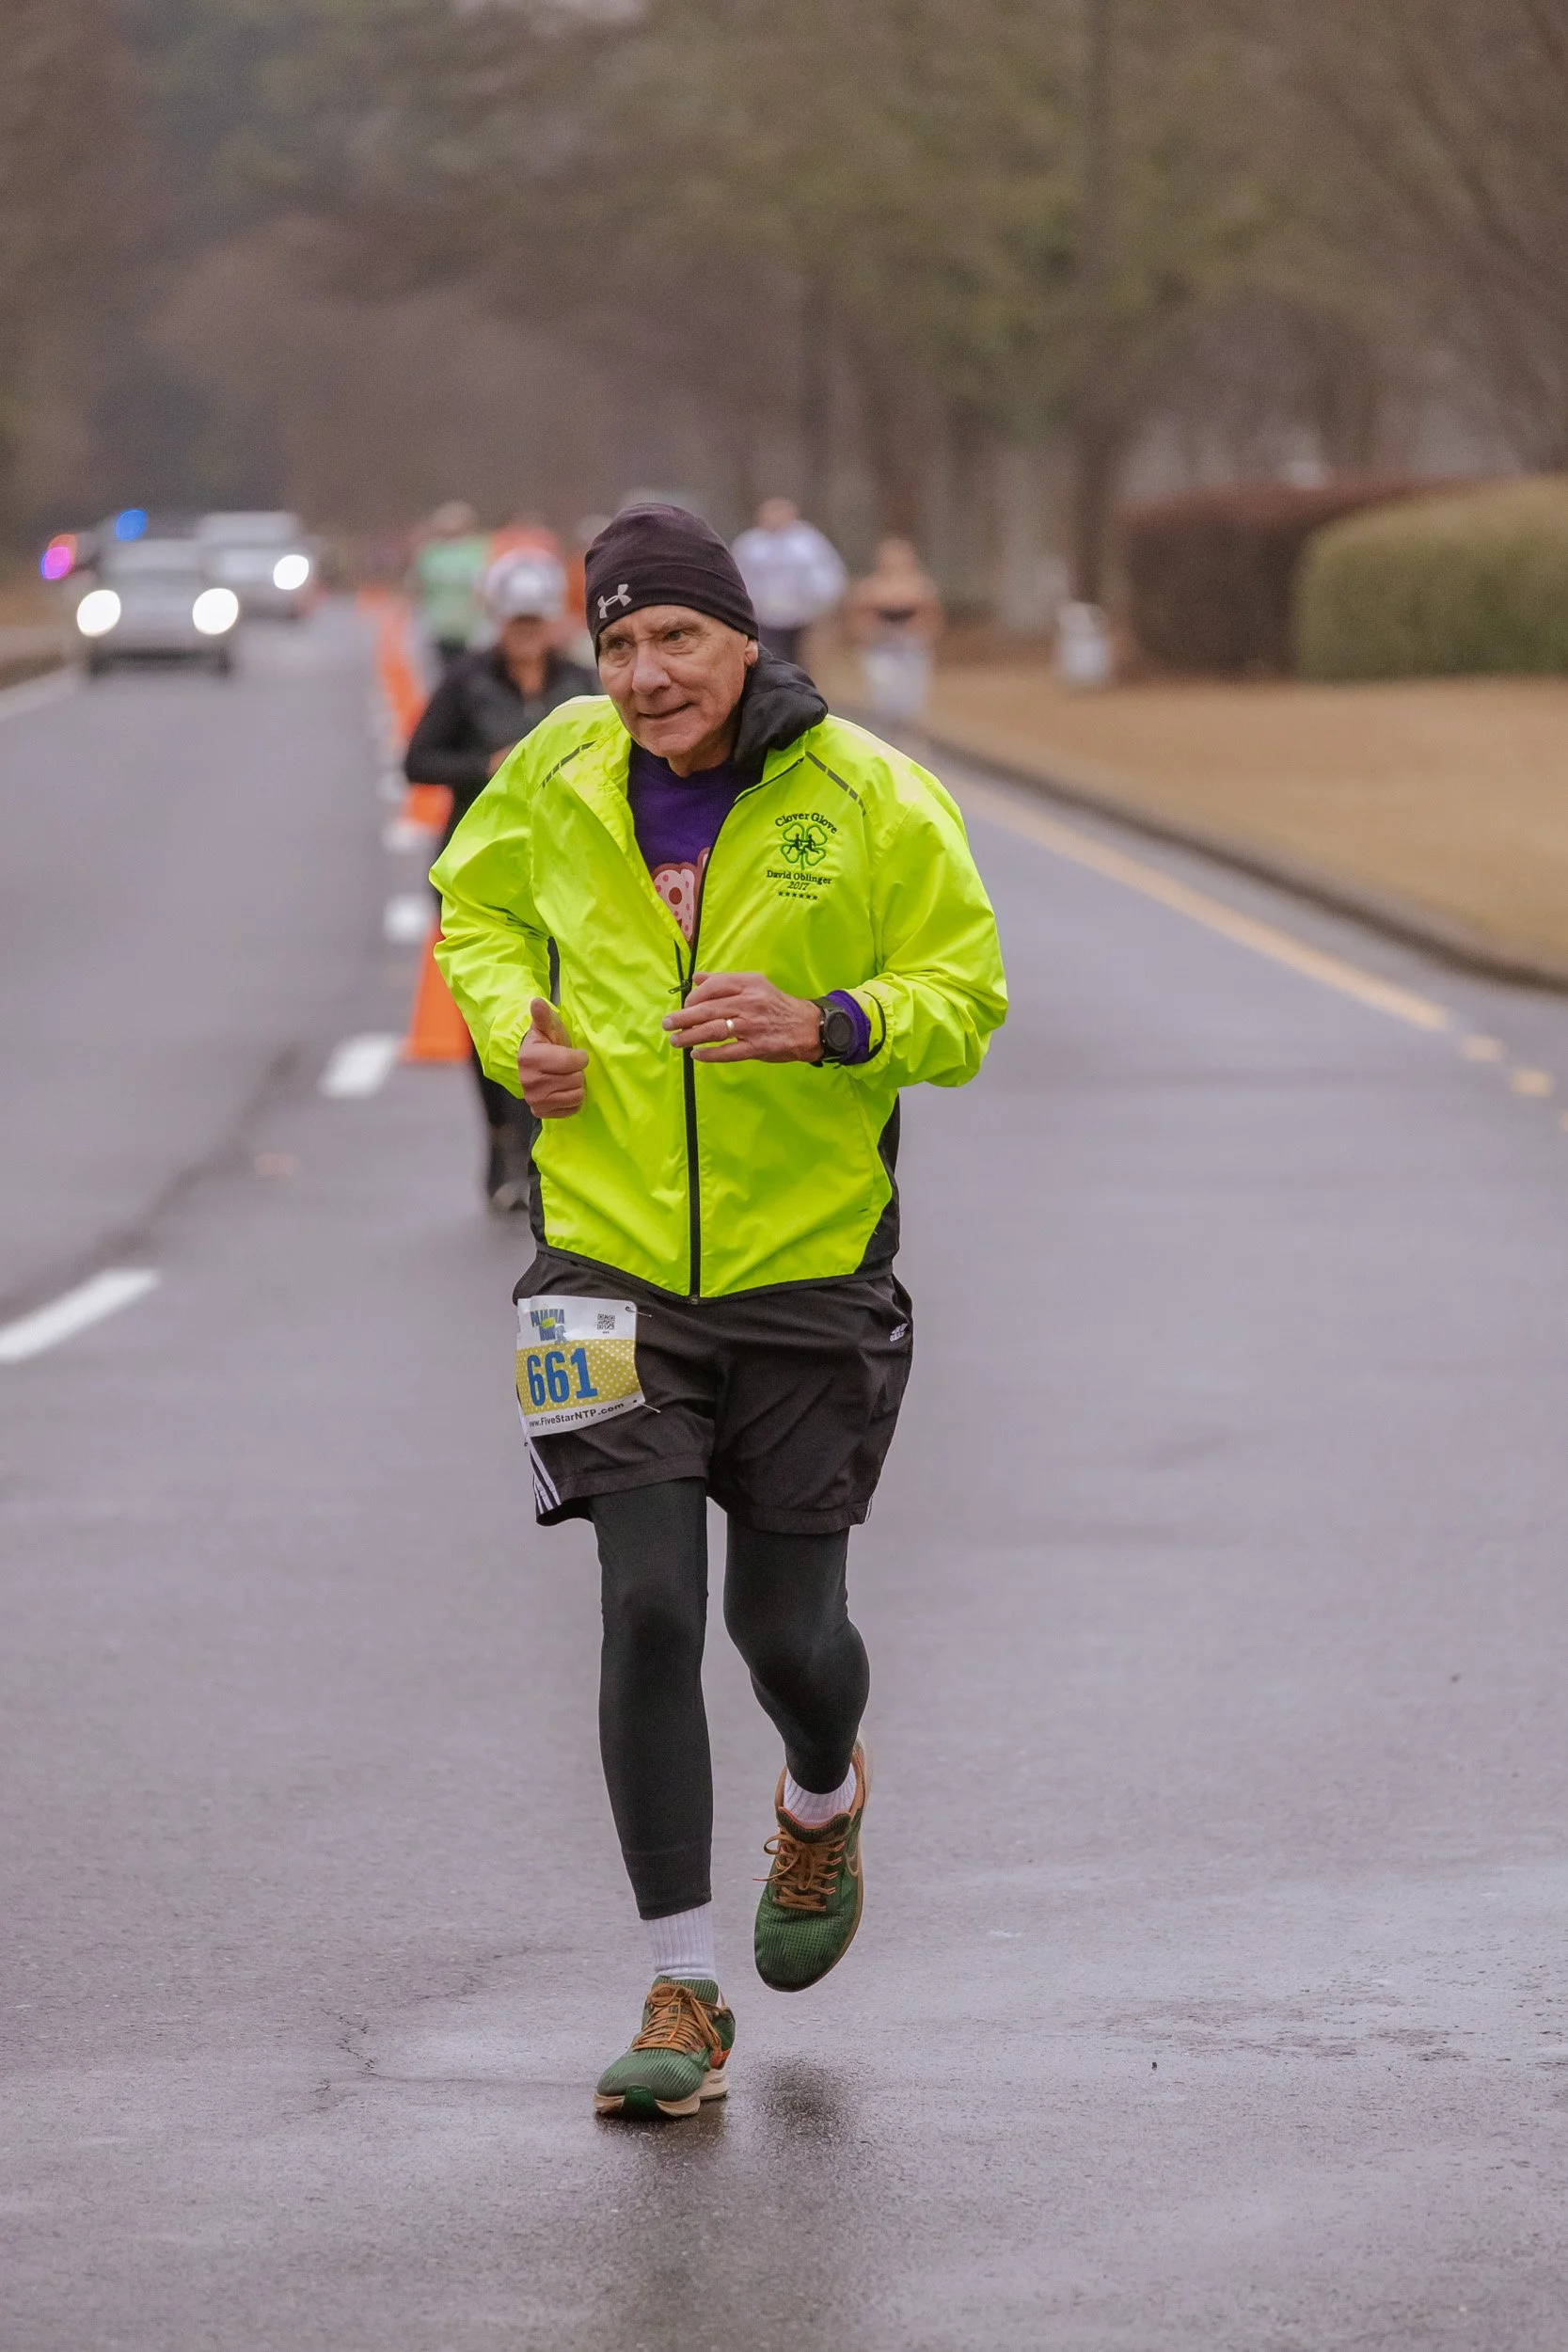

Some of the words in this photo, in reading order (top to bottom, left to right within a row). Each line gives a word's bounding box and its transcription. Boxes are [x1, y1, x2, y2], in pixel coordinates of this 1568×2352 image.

[775, 812, 810, 827] Clover
[811, 812, 837, 834] Glove
[767, 869, 792, 880] David
[793, 873, 832, 885] Oblinger
[787, 882, 809, 891] 2017
[527, 1347, 598, 1406] 661
